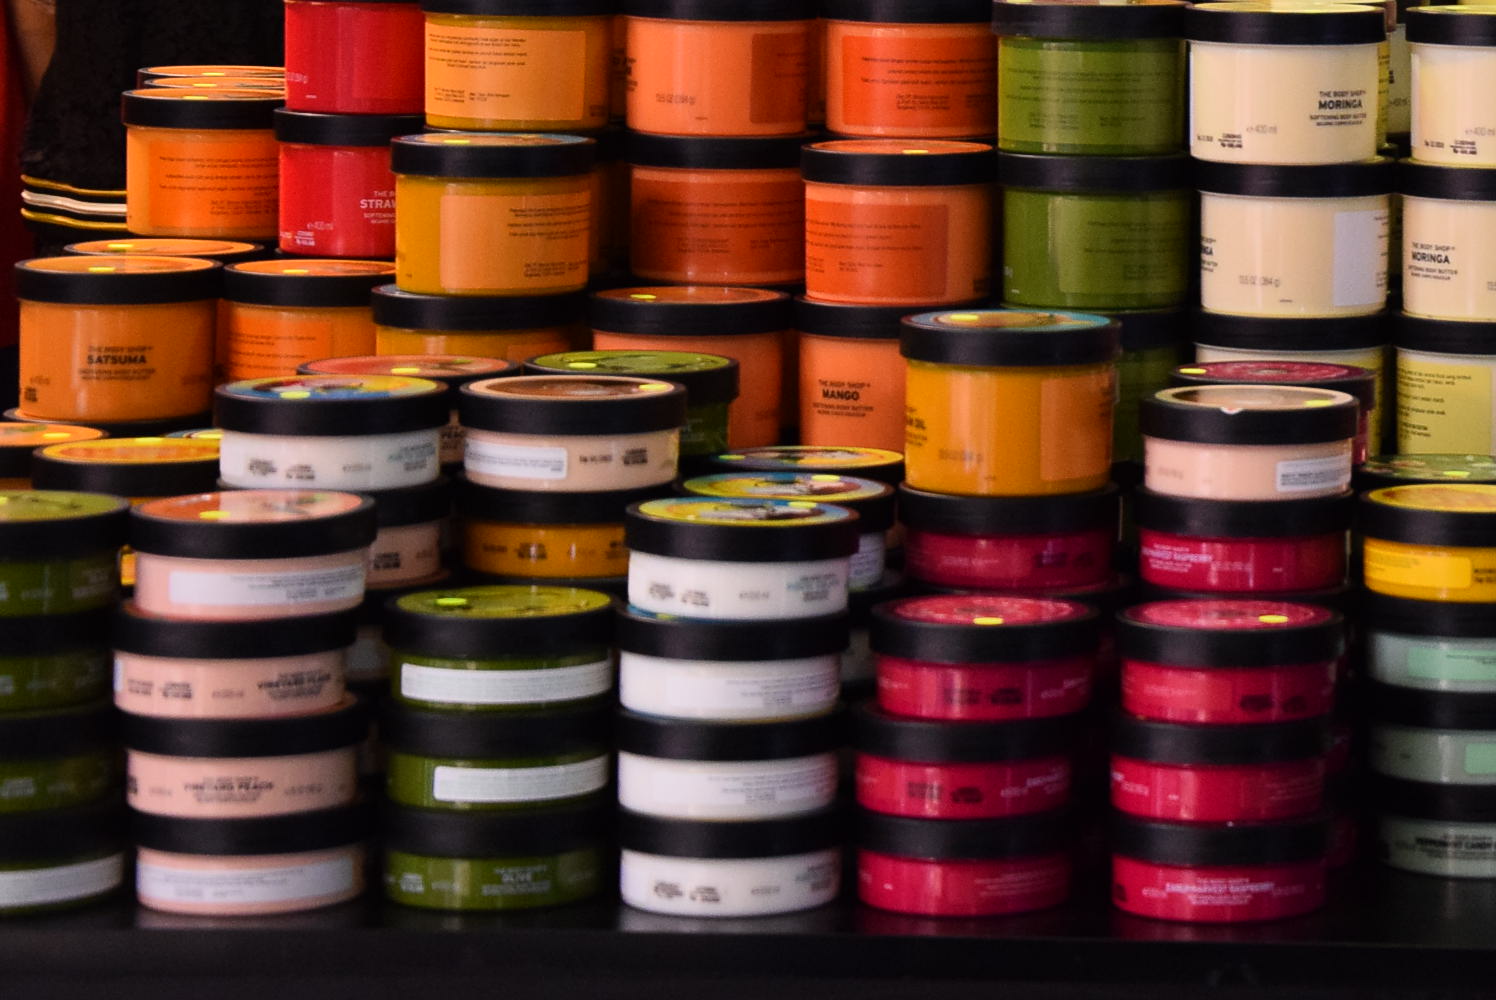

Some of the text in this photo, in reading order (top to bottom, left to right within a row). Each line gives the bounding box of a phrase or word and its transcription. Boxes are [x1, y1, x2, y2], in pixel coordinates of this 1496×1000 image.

[1318, 98, 1363, 111] MORINGA
[360, 198, 396, 209] STRA
[1411, 250, 1451, 265] MORINGA
[87, 354, 147, 365] SATSUMA
[822, 388, 860, 401] MANGO
